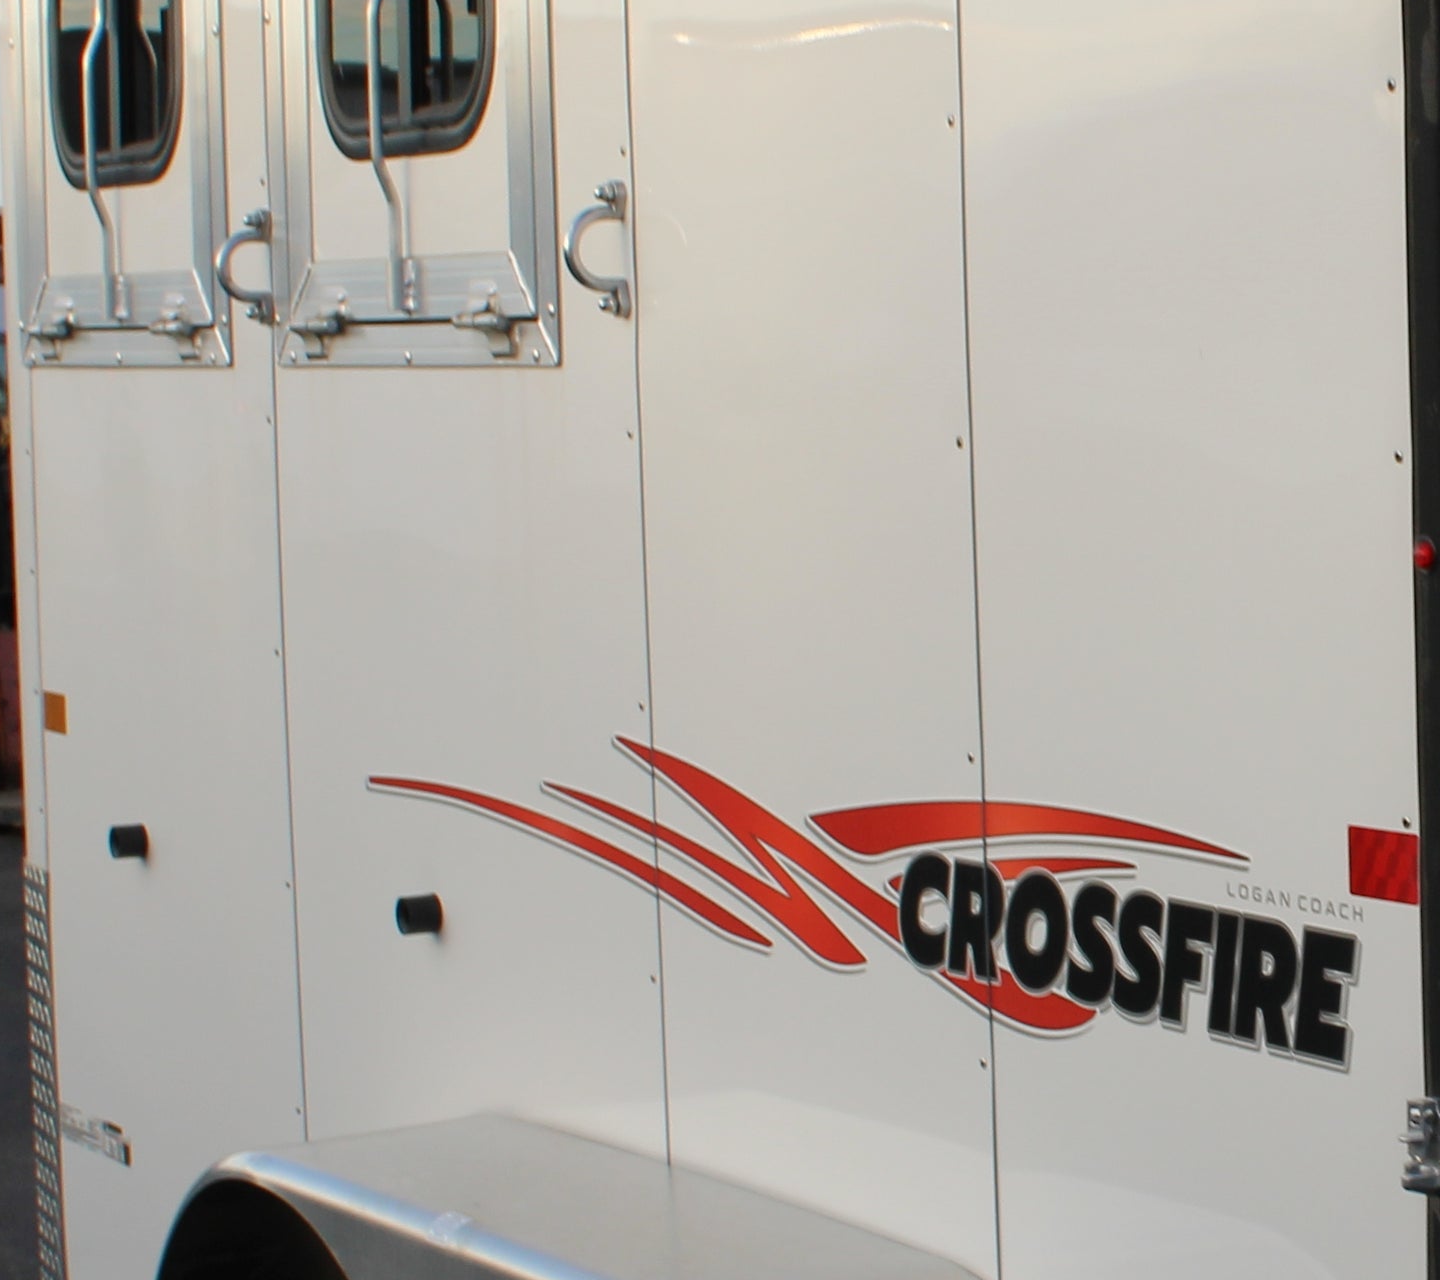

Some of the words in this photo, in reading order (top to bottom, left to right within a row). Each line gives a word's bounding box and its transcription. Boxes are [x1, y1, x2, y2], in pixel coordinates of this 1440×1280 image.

[897, 849, 1363, 1073] CROSSFIRE
[1226, 881, 1291, 908] LOGAN
[1297, 894, 1364, 922] COACH
